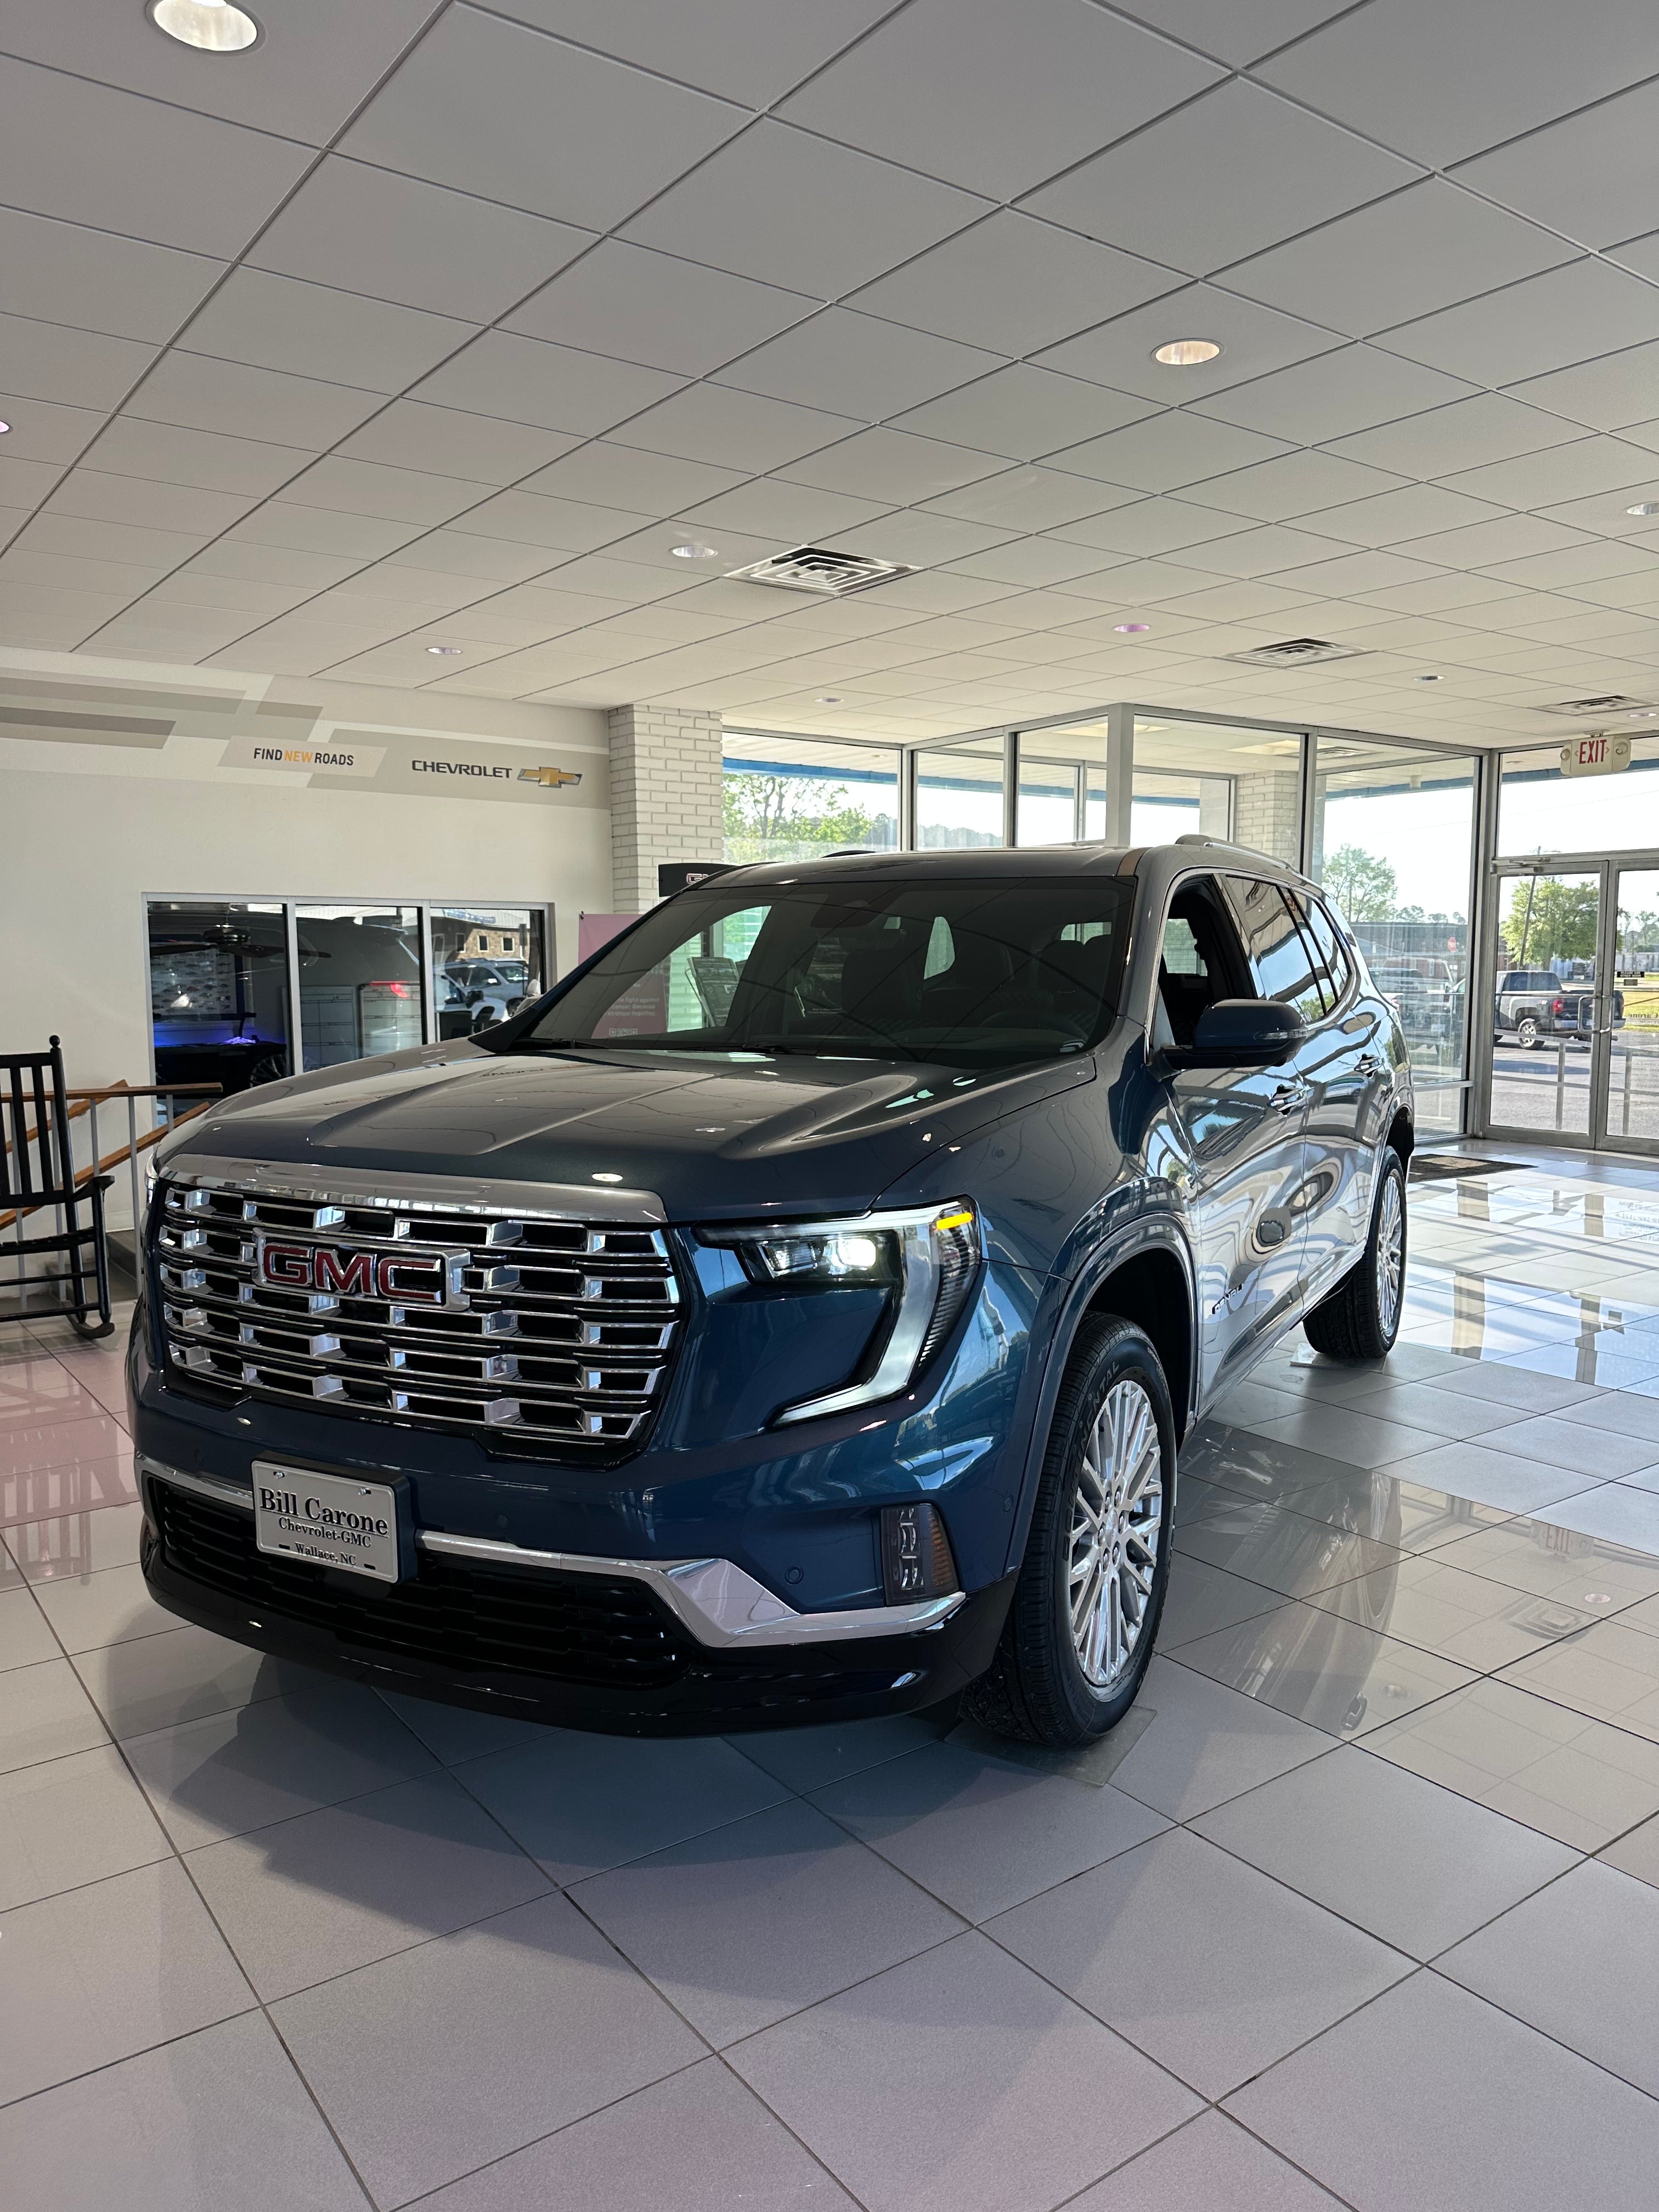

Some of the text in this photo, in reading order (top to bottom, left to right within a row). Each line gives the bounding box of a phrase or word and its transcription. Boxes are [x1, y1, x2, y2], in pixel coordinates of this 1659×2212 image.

[253, 748, 354, 766] FIND NEW ROADS
[1579, 739, 1607, 764] EXIT
[411, 760, 513, 778] CHEVROLET
[263, 1243, 441, 1303] GMC
[259, 1487, 388, 1535] Bill Carone
[279, 1517, 371, 1548] Chevrolet-GMC
[295, 1541, 357, 1566] Wallace, NC
